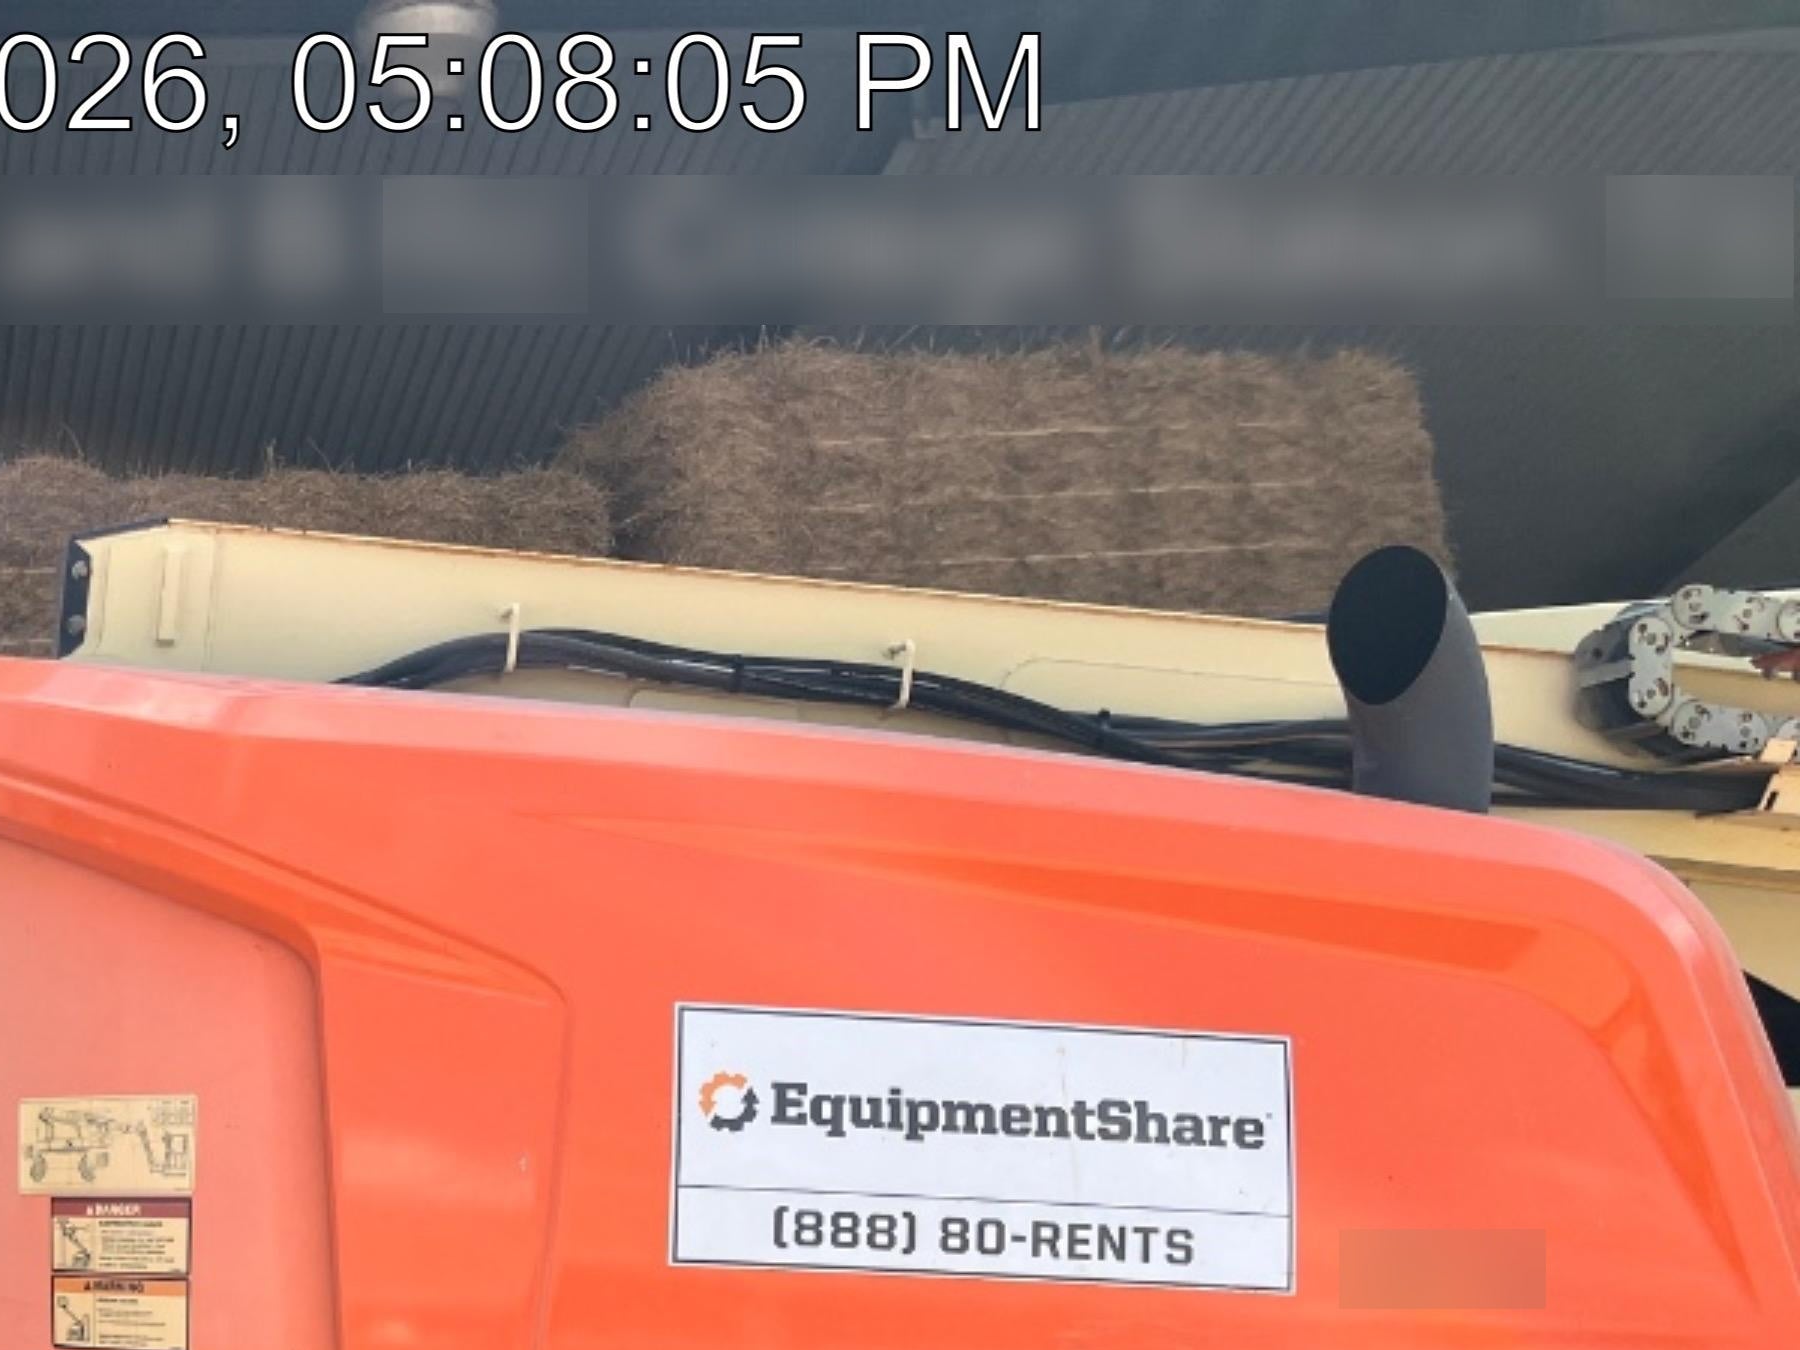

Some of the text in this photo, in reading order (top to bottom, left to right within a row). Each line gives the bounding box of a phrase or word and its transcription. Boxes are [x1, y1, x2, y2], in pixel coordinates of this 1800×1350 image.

[770, 1081, 1265, 1150] EquipmentShare
[773, 1205, 1194, 1266] (888) 80-RENTS
